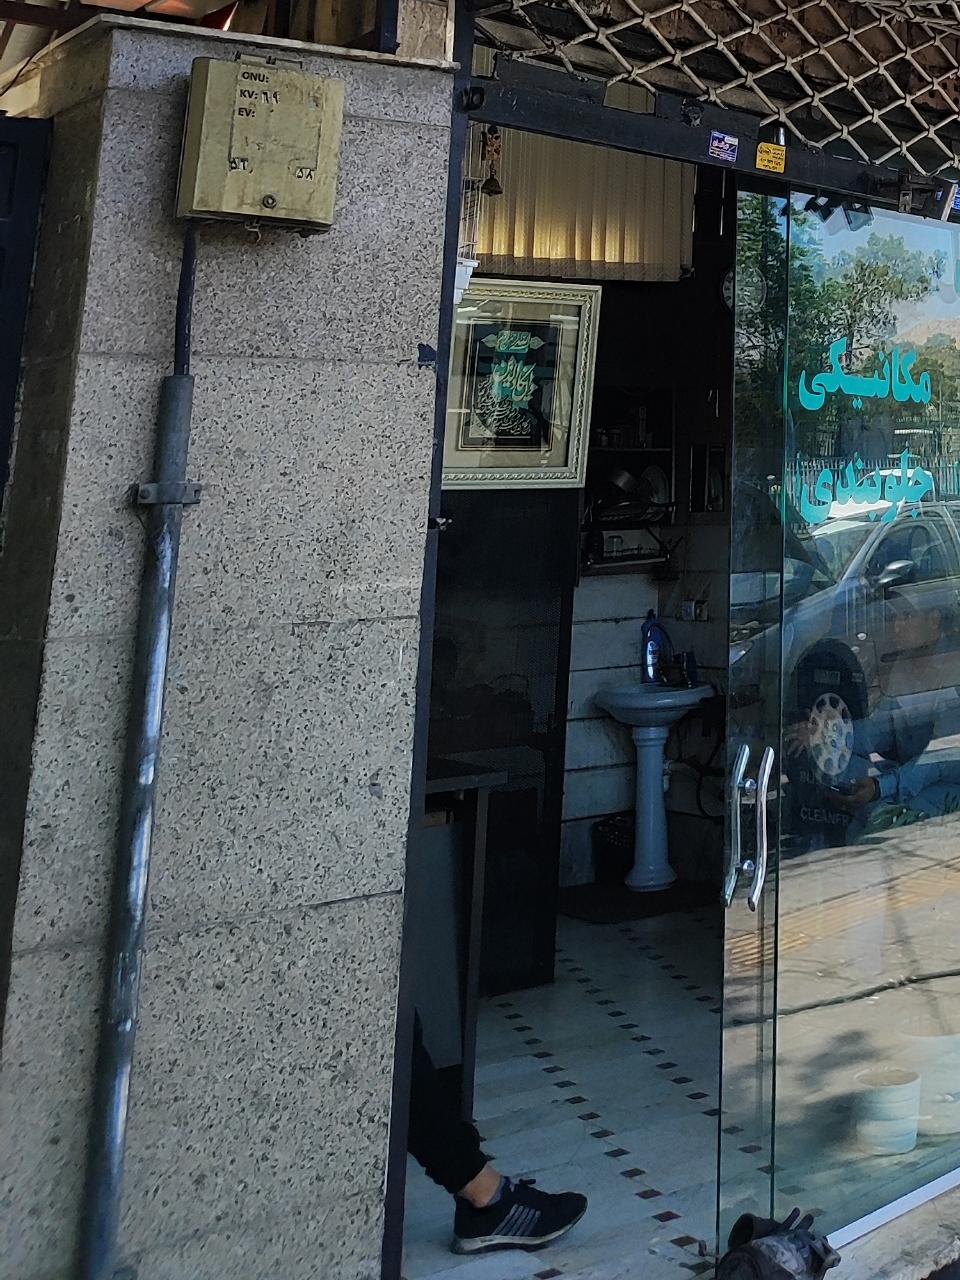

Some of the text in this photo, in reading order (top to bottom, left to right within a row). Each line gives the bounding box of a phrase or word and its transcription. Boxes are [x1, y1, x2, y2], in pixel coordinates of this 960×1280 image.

[242, 71, 270, 83] ONU:
[240, 88, 258, 100] KV:
[237, 107, 256, 118] EV:
[798, 336, 933, 411] مکانیکی
